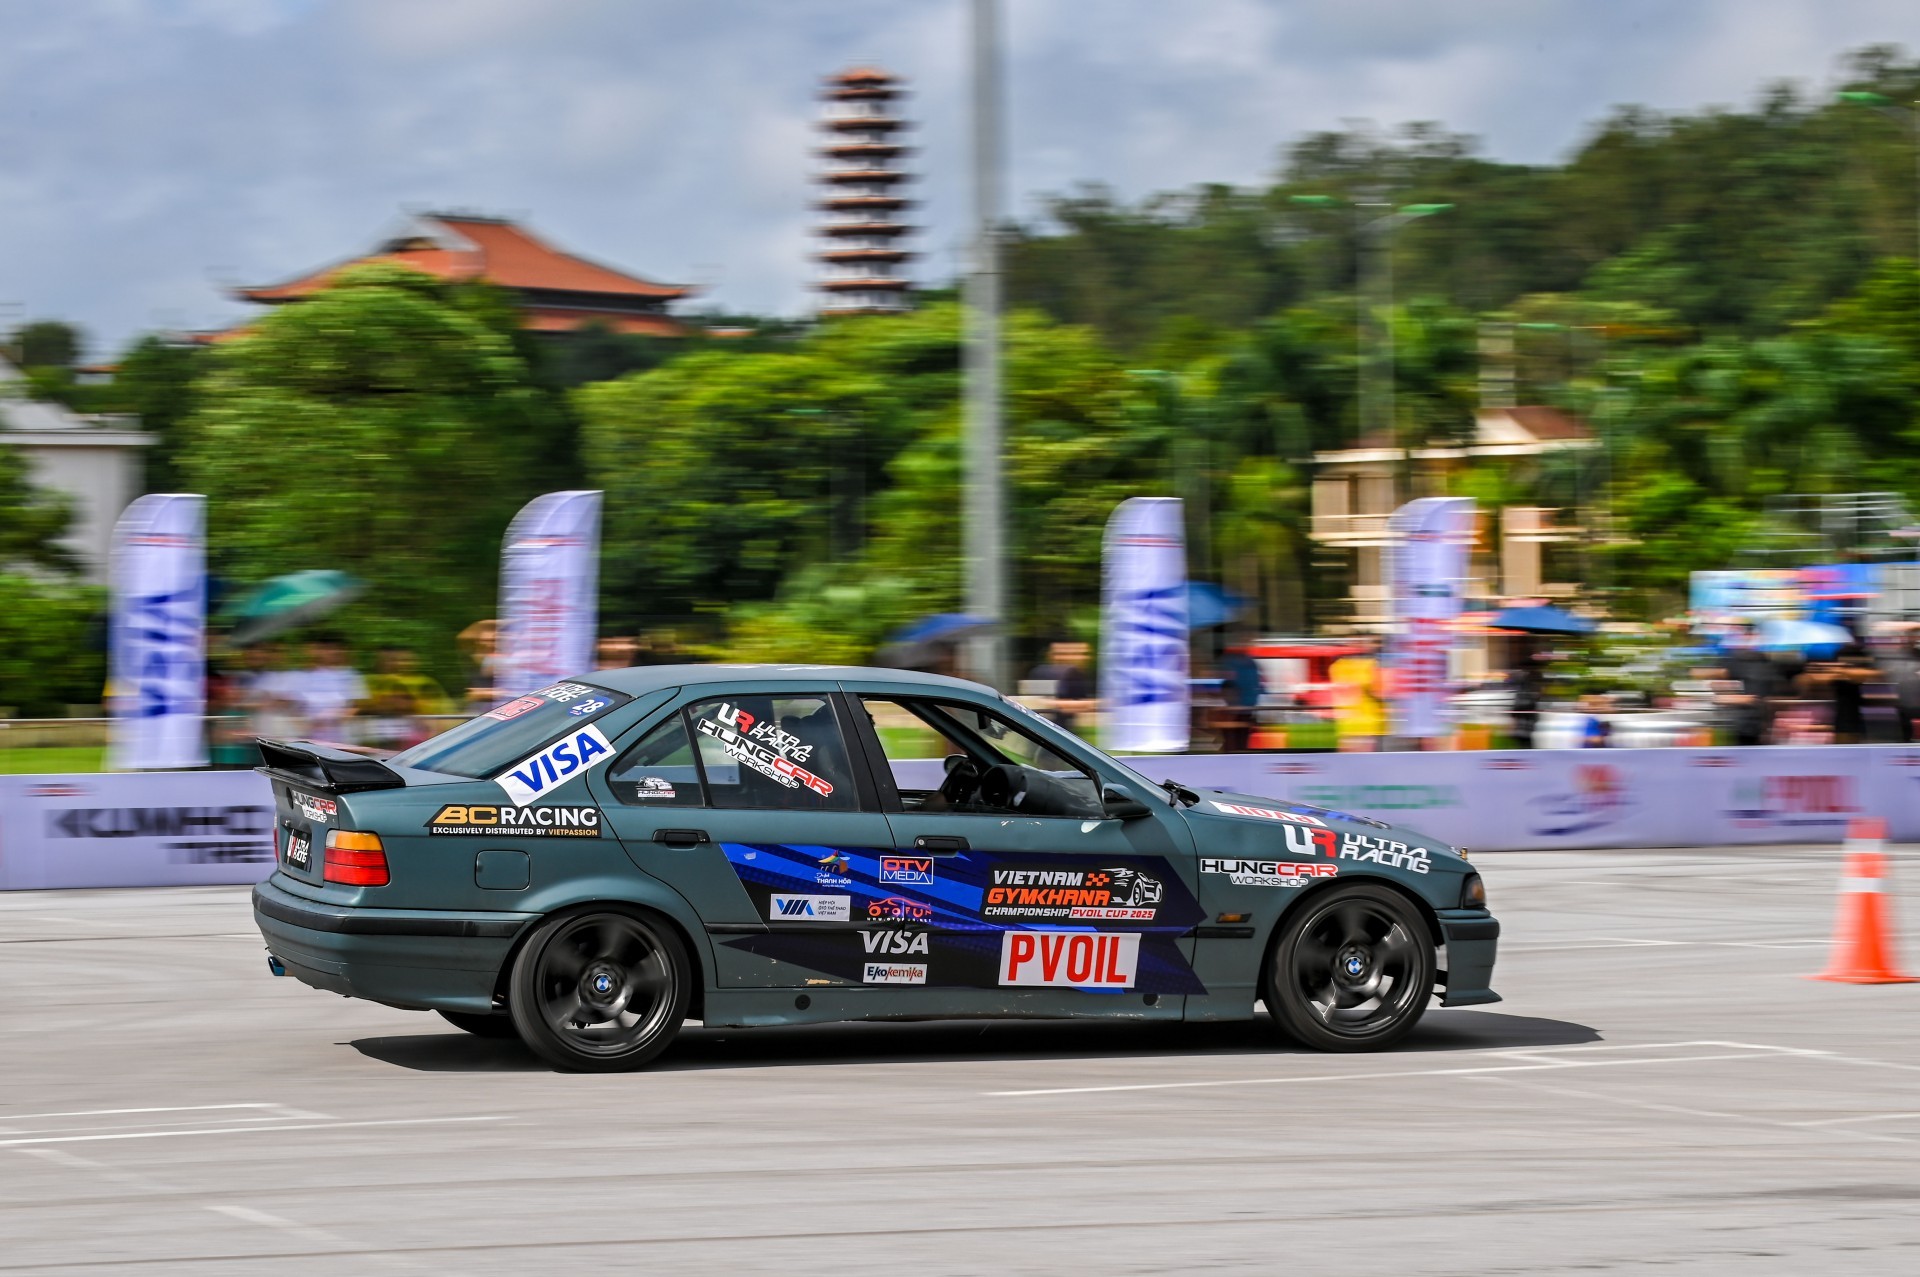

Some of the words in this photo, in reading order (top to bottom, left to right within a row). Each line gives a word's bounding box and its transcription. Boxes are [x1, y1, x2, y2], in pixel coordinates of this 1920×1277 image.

[571, 699, 605, 713] 28
[749, 725, 810, 763] RACING
[756, 721, 814, 755] ULTRA
[505, 732, 607, 792] VISA
[698, 719, 833, 797] HUNGCAR
[724, 745, 799, 789] WORKSHOP
[501, 807, 598, 827] RACING
[1283, 824, 1337, 858] UR
[1343, 833, 1427, 857] ULTRA
[883, 859, 930, 871] OTV
[1201, 859, 1339, 877] HUNGCAR
[1340, 844, 1432, 875] RACING
[883, 870, 930, 883] MEDIA
[993, 870, 1083, 886] VIETNAM
[1231, 875, 1308, 886] WORKSHOP
[987, 888, 1110, 906] GYMKHANA
[868, 905, 932, 918] OTOFUN
[984, 907, 1070, 917] CHAMPIONSHIP
[1072, 909, 1103, 918] PVOIL
[1105, 910, 1127, 918] CUP
[1130, 910, 1153, 918] 2025
[857, 930, 929, 955] VISA
[1007, 934, 1127, 983] PVOIL
[867, 966, 923, 980] Ekokemika
